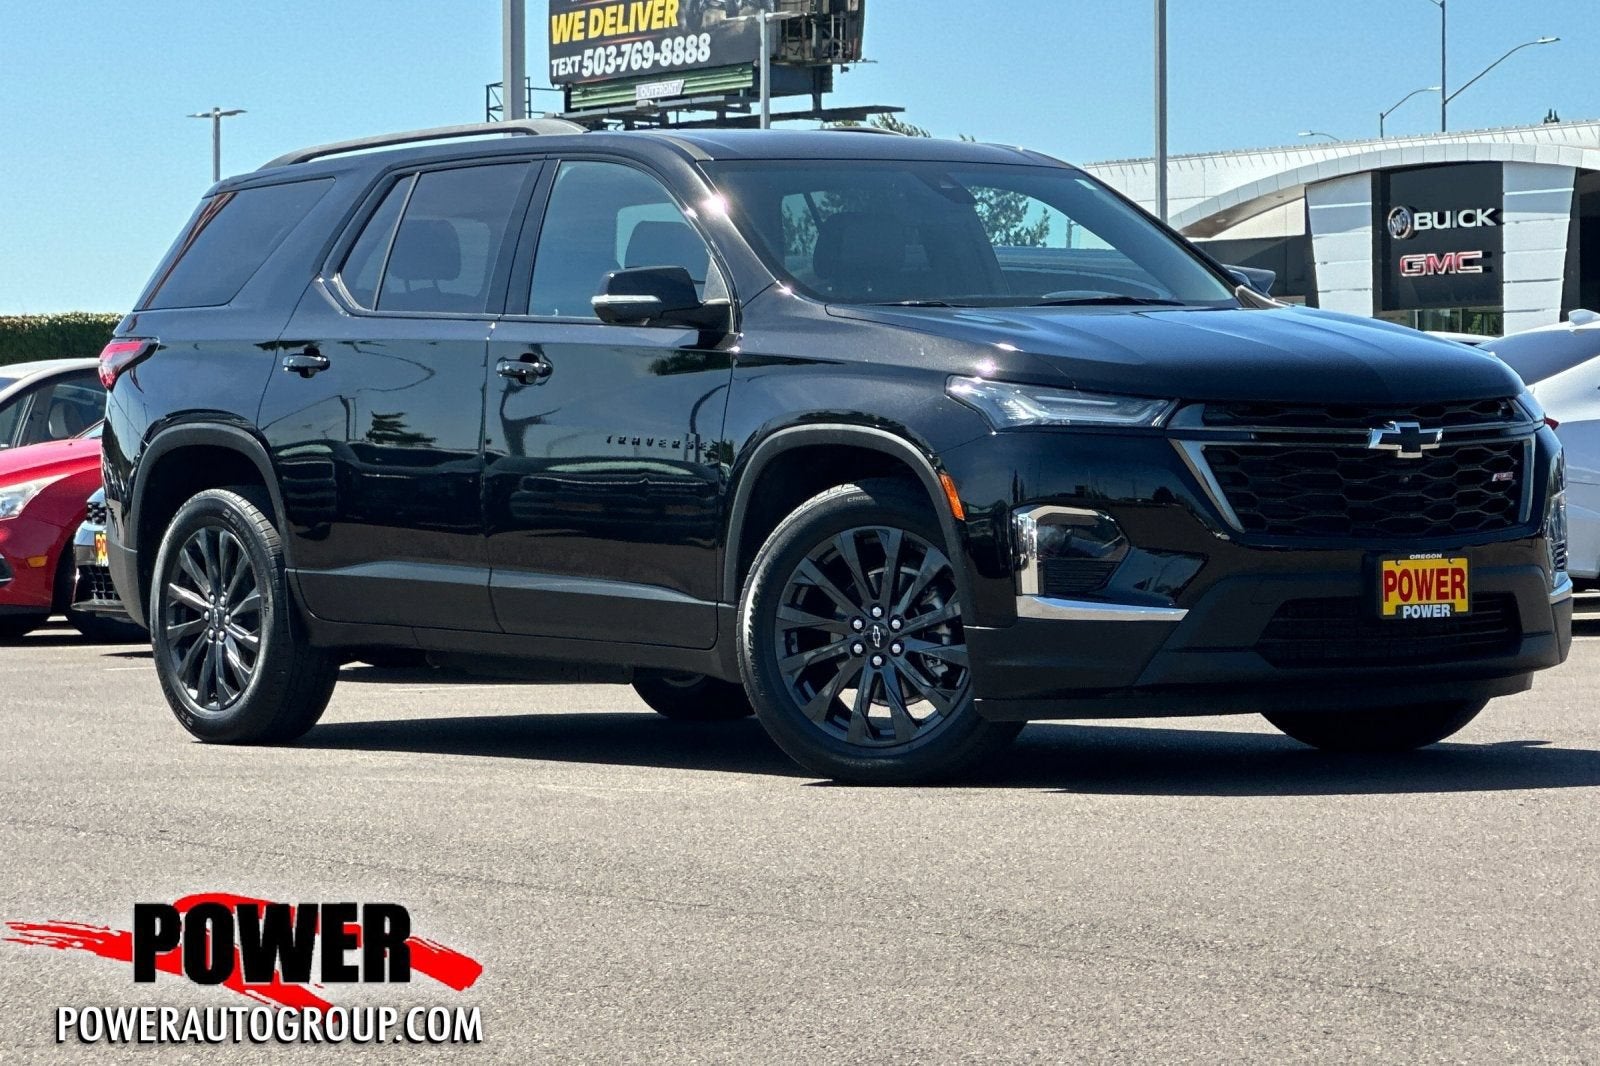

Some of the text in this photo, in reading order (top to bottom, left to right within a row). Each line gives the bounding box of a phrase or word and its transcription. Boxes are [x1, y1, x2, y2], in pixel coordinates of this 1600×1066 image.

[552, 0, 679, 45] WE DELIVER
[551, 32, 711, 77] TEXT 503-769-8888
[1413, 208, 1497, 231] BUICK
[1400, 250, 1483, 277] GMC
[1383, 567, 1466, 602] POWER
[1402, 603, 1451, 619] POWER
